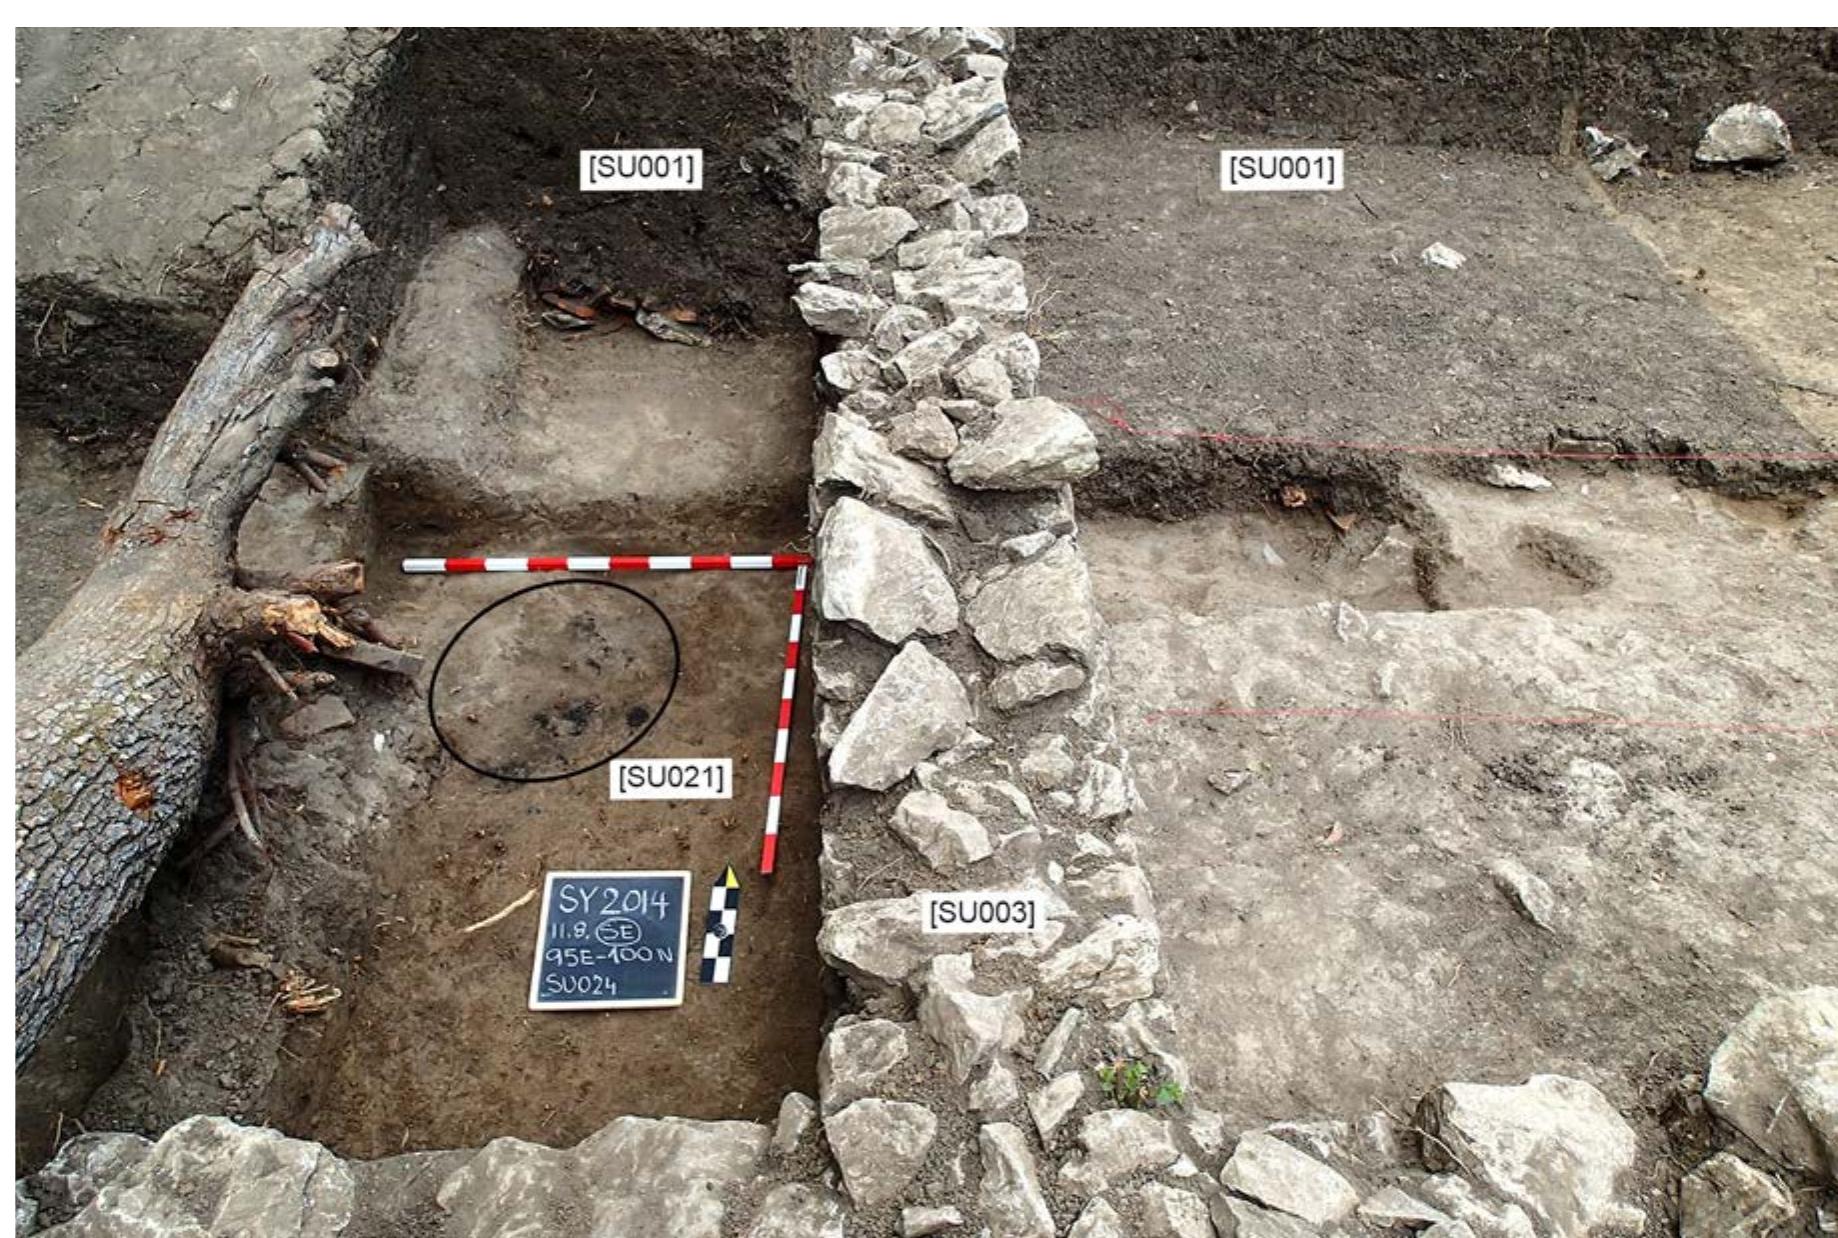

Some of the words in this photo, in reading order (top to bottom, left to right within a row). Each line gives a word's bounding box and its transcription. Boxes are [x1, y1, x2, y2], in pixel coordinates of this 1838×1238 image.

[559, 884, 598, 914] SY
[600, 887, 670, 920] 2014
[601, 925, 635, 940] SE
[545, 973, 617, 995] SU024
